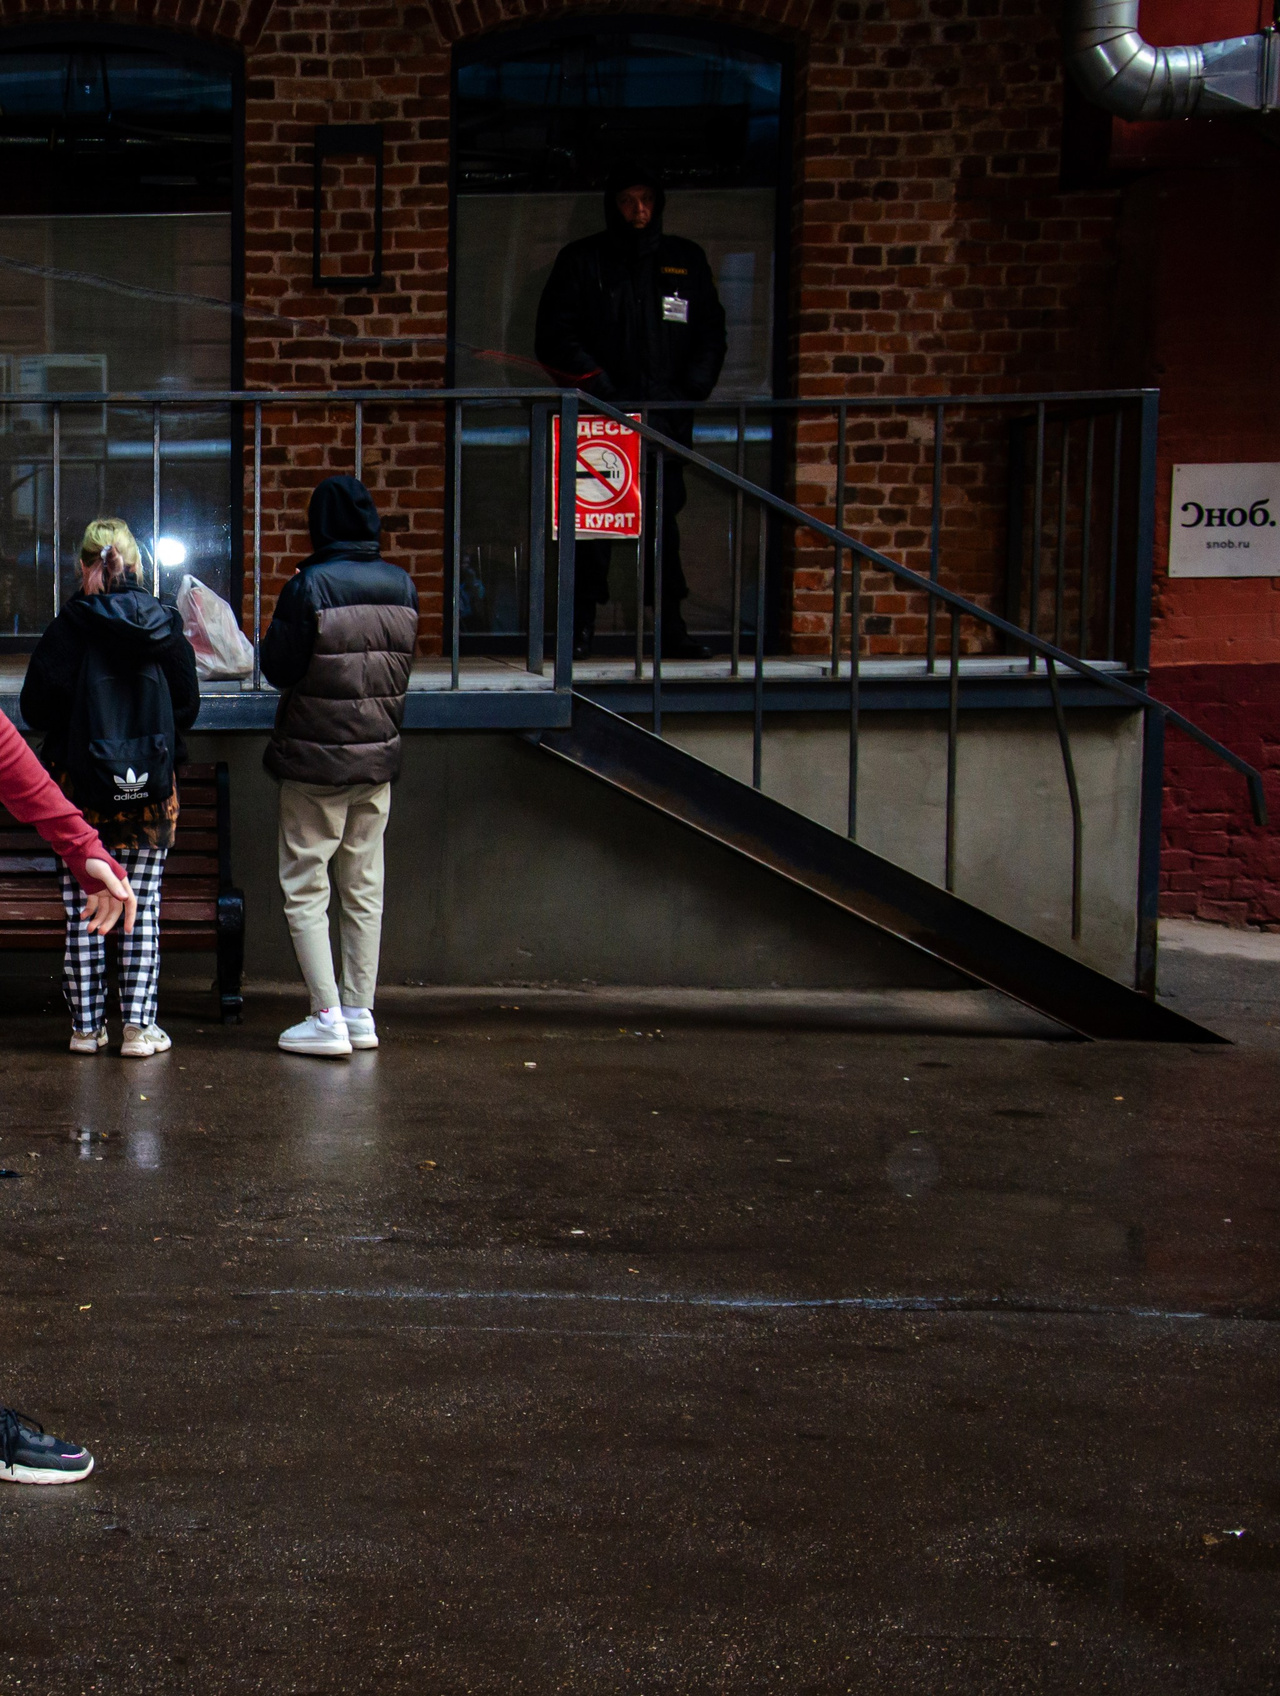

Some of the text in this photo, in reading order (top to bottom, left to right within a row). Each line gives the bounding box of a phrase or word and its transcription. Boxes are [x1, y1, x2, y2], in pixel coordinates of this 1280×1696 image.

[576, 420, 634, 438] ДЕСЬ
[585, 512, 635, 528] КУРЯТ
[1206, 540, 1250, 549] snob.ru
[114, 791, 149, 801] adidas
